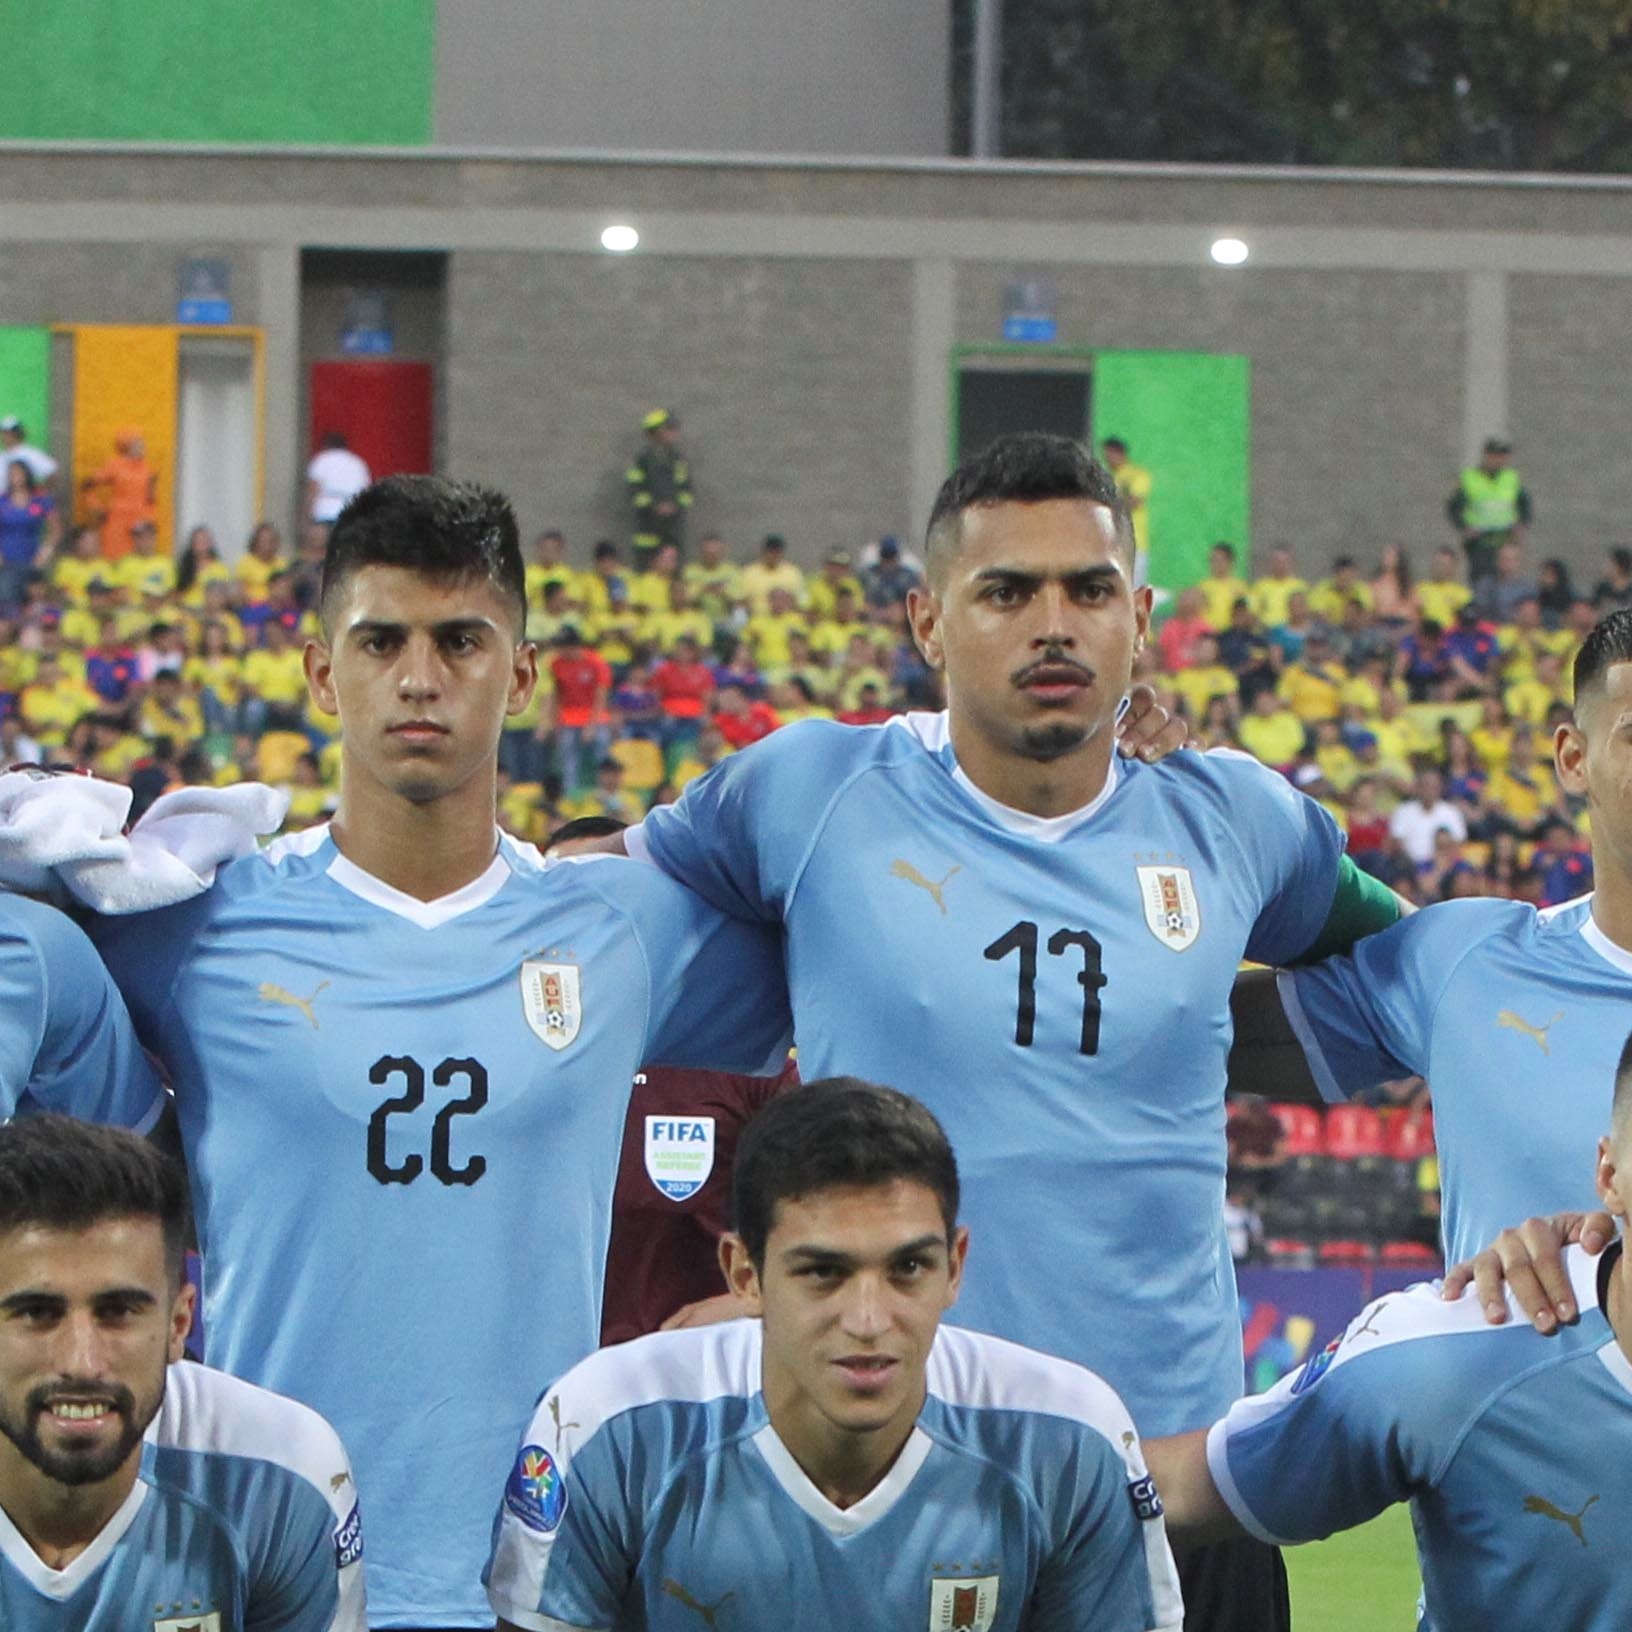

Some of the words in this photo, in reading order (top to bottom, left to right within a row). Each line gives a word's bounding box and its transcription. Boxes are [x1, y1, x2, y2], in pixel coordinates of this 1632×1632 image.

[984, 921, 1108, 1056] 17
[347, 1055, 488, 1186] 22
[653, 1122, 707, 1141] FIFA
[666, 1182, 693, 1192] 2020
